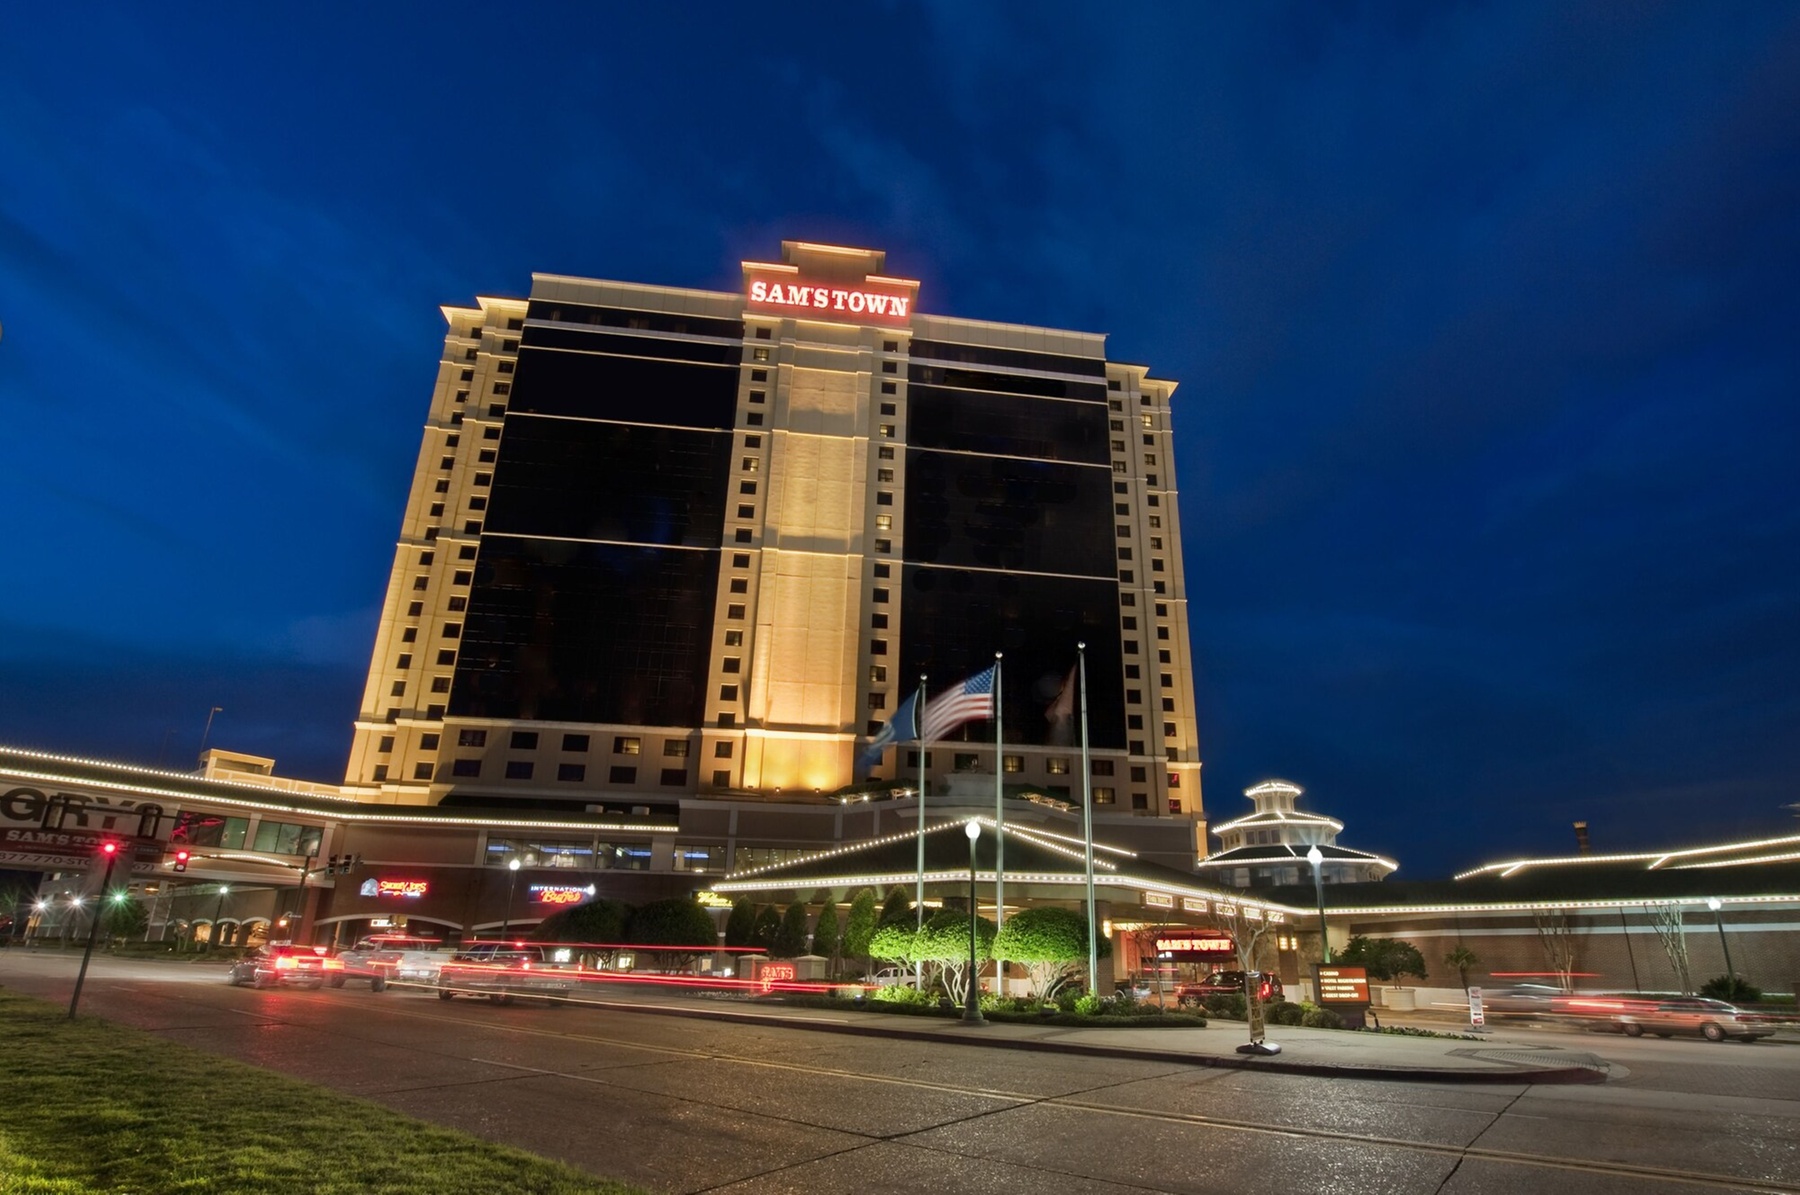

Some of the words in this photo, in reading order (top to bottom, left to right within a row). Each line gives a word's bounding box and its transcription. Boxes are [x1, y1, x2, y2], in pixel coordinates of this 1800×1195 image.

[751, 280, 829, 309] SAM'S
[832, 289, 909, 317] TOWN
[6, 829, 71, 846] SAM'S
[72, 835, 131, 852] TON
[530, 885, 592, 893] INTERNATIONA
